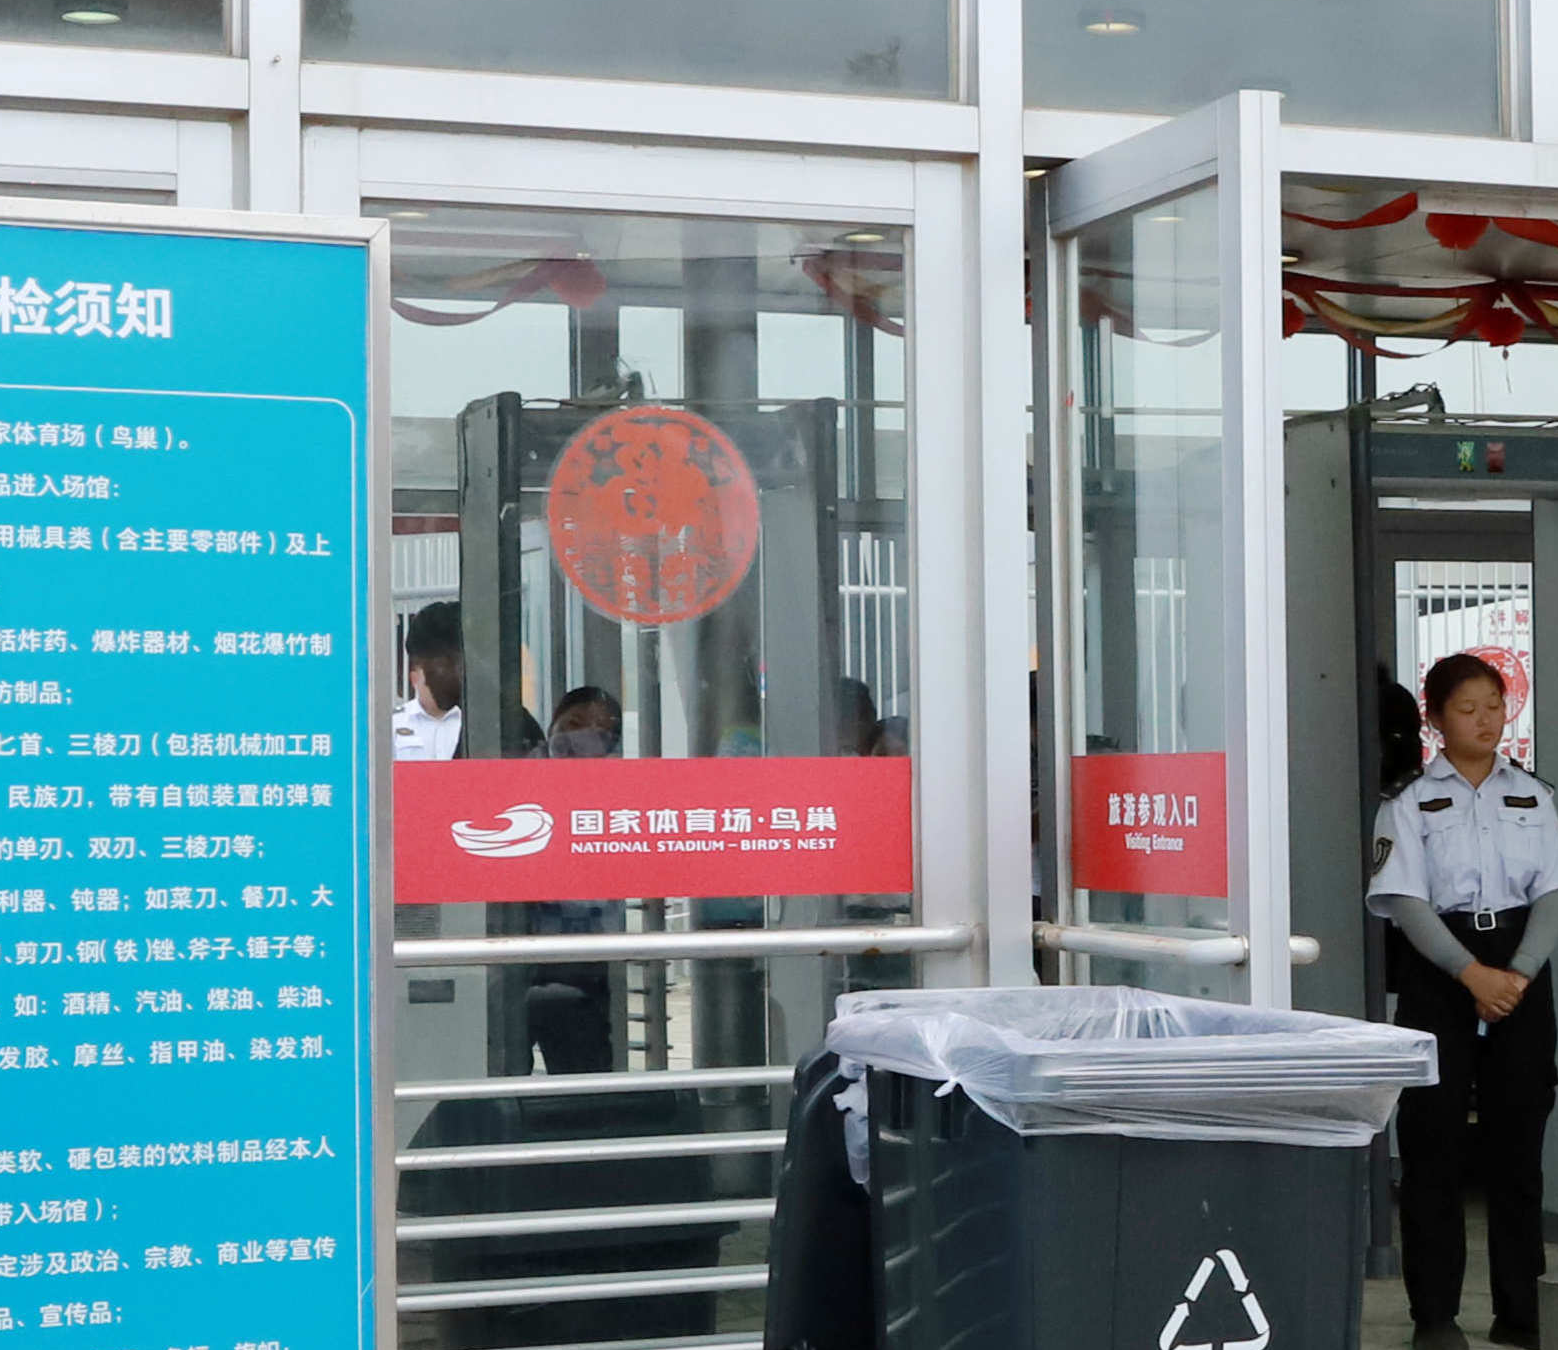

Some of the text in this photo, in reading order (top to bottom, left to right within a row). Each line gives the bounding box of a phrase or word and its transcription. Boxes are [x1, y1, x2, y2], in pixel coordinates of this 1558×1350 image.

[1108, 792, 1197, 826] 旅游参观入口
[571, 841, 651, 854] NATIONAL
[657, 839, 724, 852] STADIUM
[740, 839, 791, 851] BIRD'S
[797, 837, 837, 850] NEST
